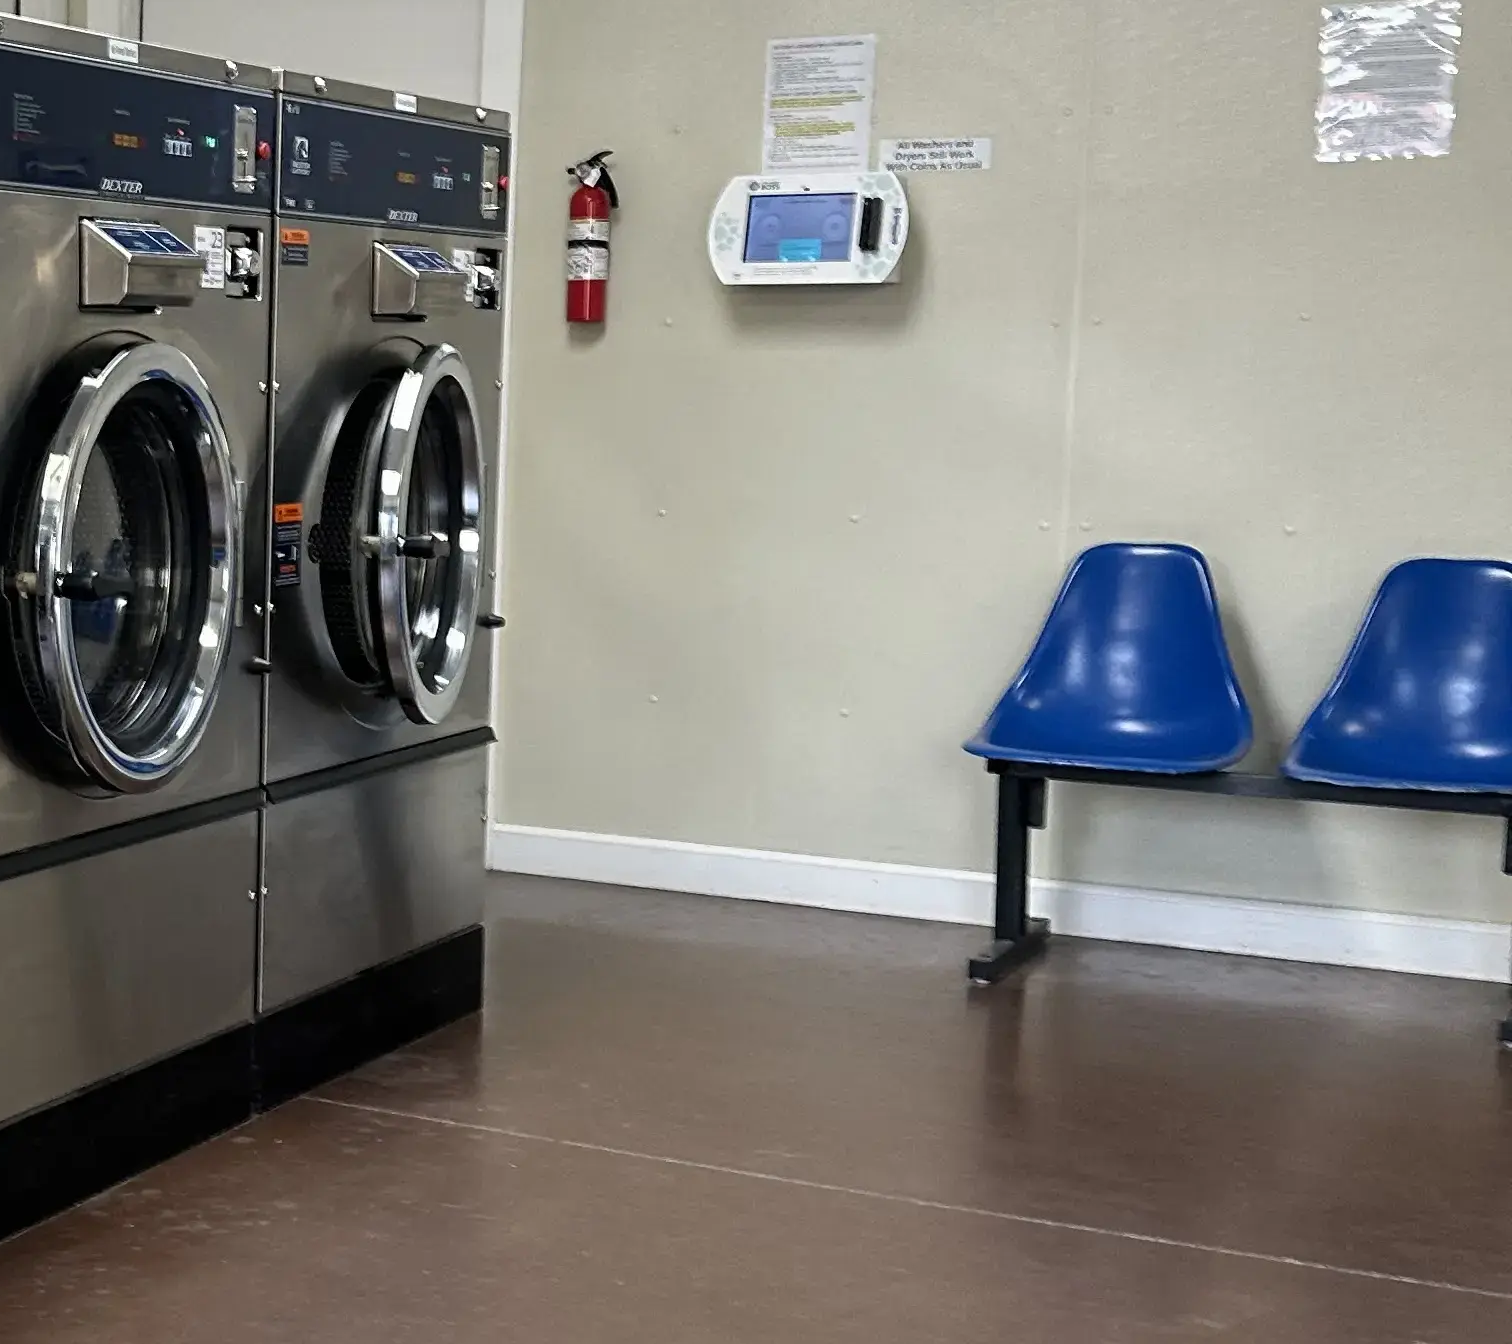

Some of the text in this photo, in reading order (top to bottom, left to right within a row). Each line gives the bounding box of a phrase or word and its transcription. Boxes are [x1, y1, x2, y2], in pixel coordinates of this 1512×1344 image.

[912, 140, 953, 149] Washers
[895, 152, 927, 161] Dryers
[949, 150, 975, 159] Work
[886, 163, 908, 172] With
[910, 162, 938, 171] Coins
[955, 161, 983, 170] Usual
[101, 178, 143, 194] DEXTER
[211, 231, 223, 249] 23
